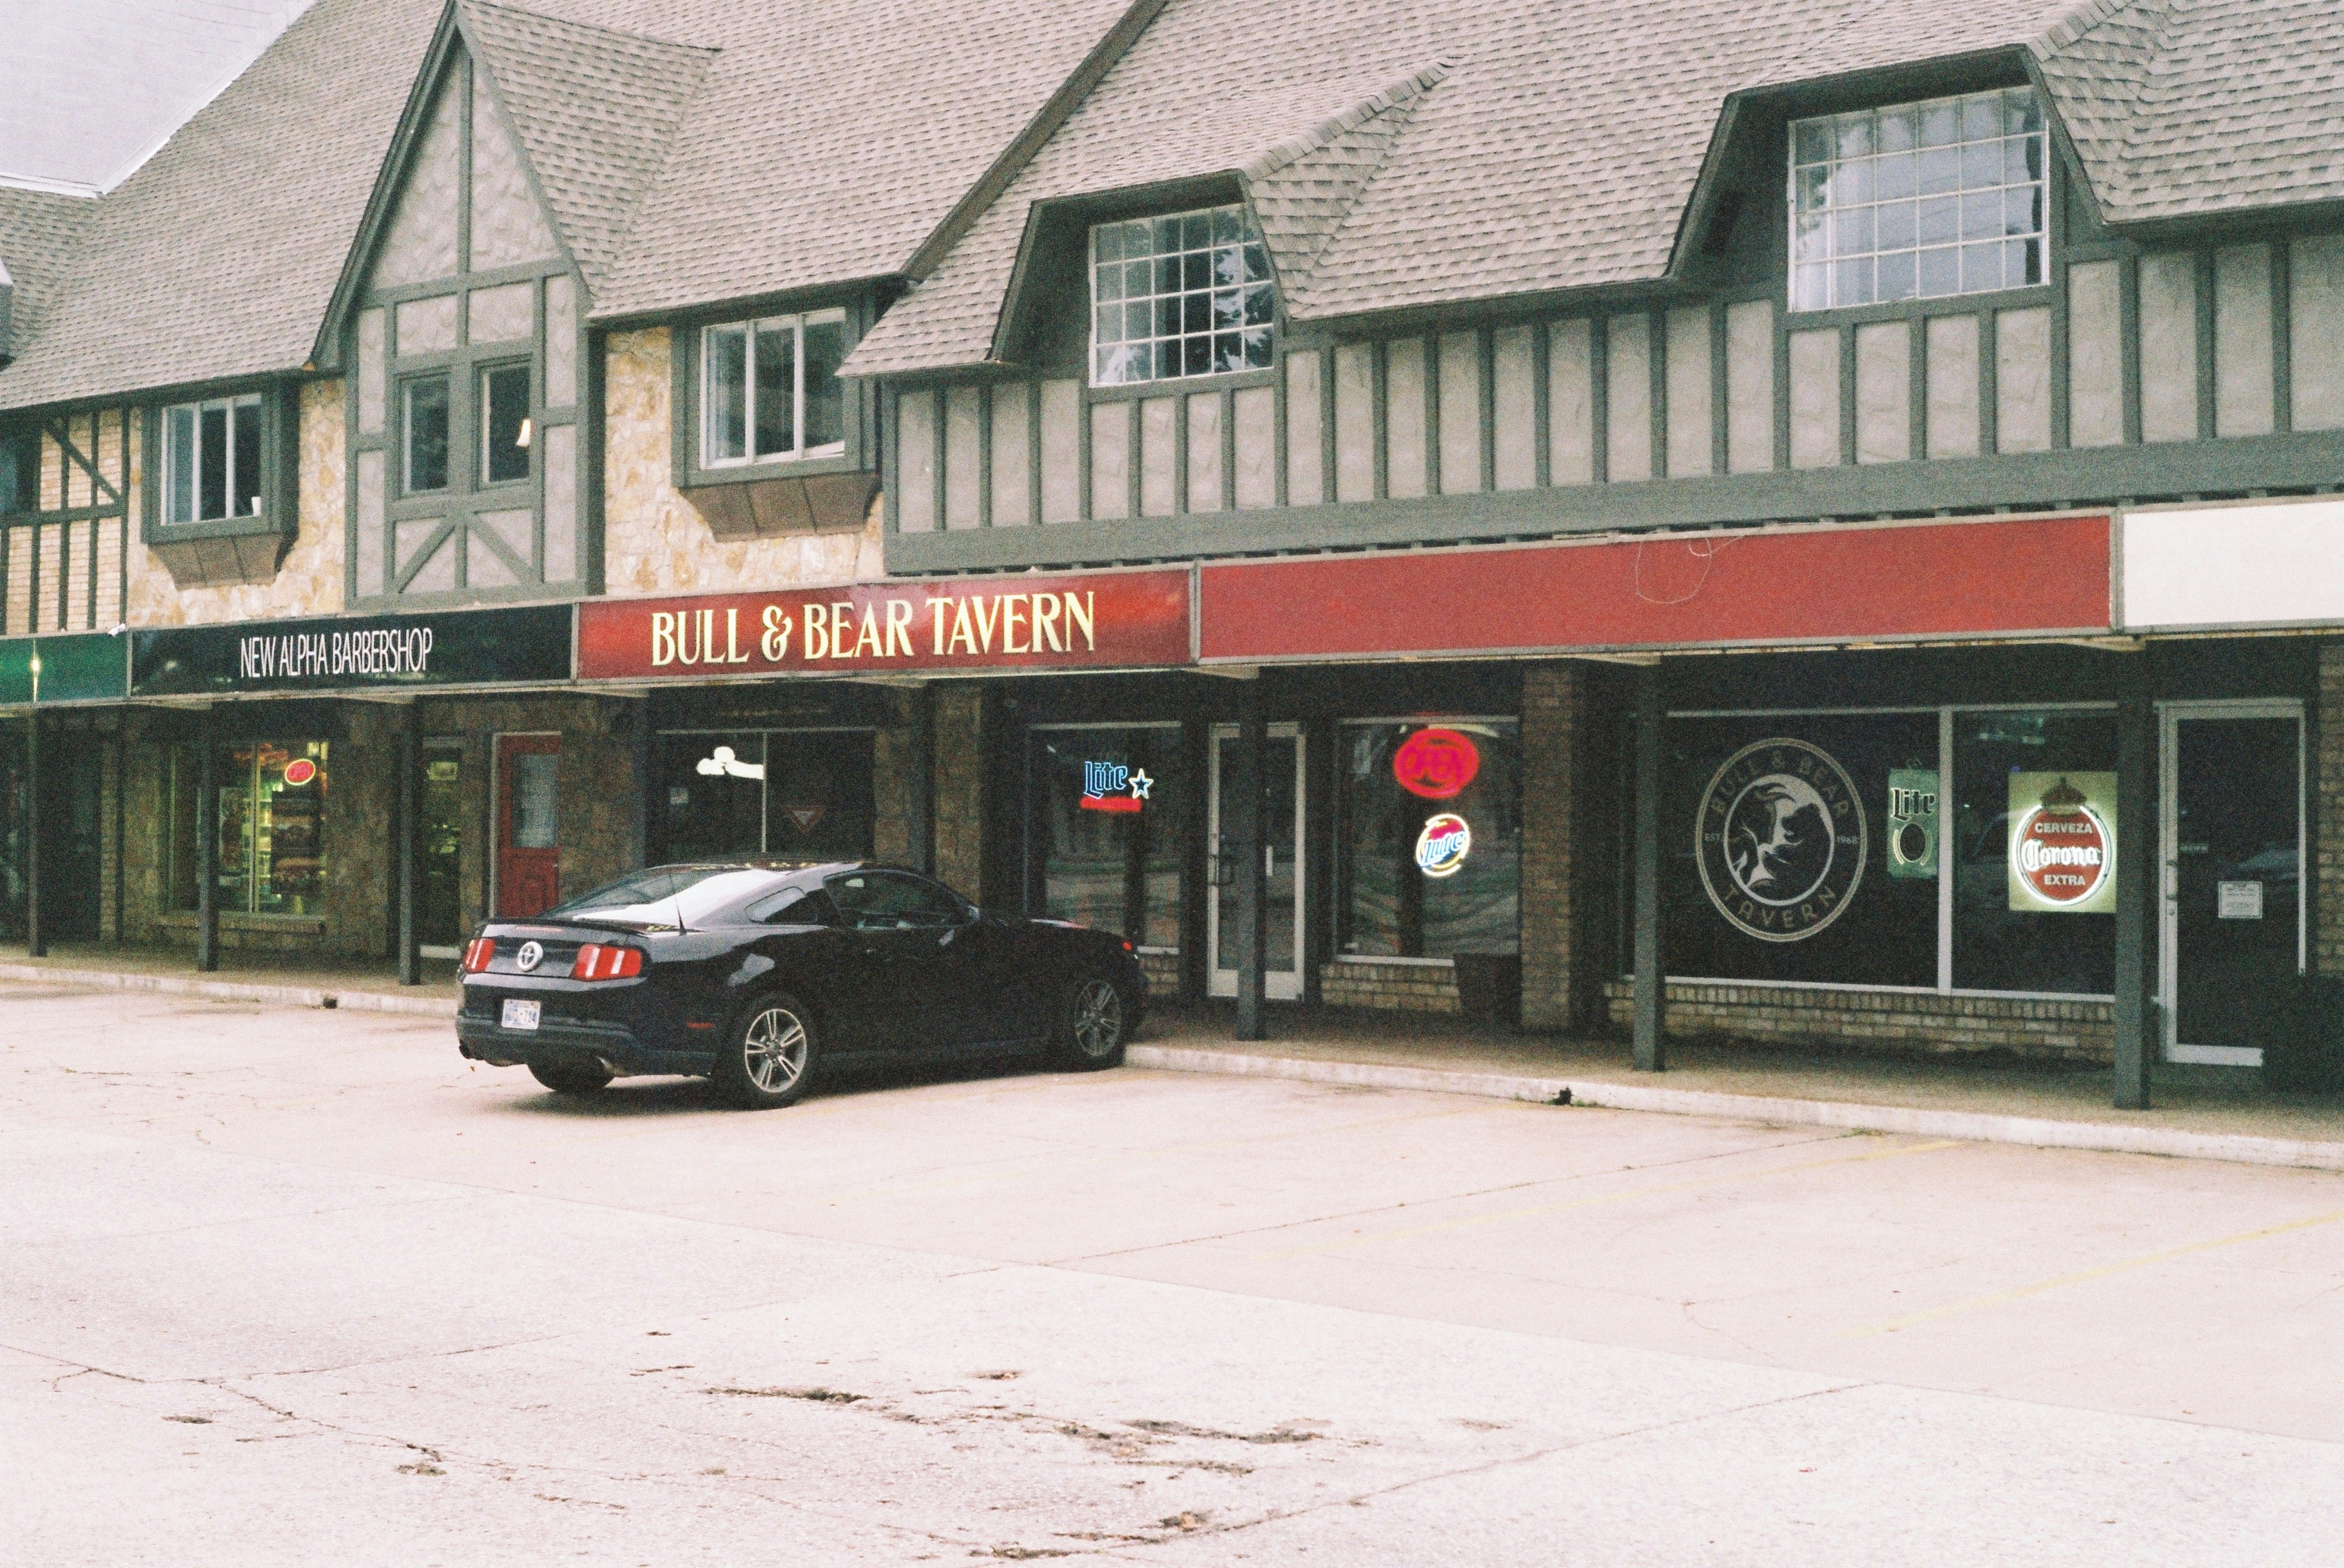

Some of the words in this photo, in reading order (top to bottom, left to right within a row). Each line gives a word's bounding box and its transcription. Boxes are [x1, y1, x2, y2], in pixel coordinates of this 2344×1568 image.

[652, 609, 751, 666] BULL
[760, 605, 793, 663] &
[802, 598, 915, 661] BEAR
[924, 591, 1095, 656] TAVERN
[240, 635, 277, 678] NEW
[278, 633, 329, 677] ALPHA
[332, 627, 433, 675] BARBERSHOP
[1083, 760, 1128, 800] Lite
[1711, 759, 1761, 815] BULL
[1797, 755, 1850, 818] BEAR
[1890, 788, 1936, 822] Lite
[2035, 822, 2093, 834] CERVEZA
[2022, 839, 2101, 872] Corona
[2044, 875, 2086, 886] EXTRA
[1724, 884, 1837, 929] TAVERN
